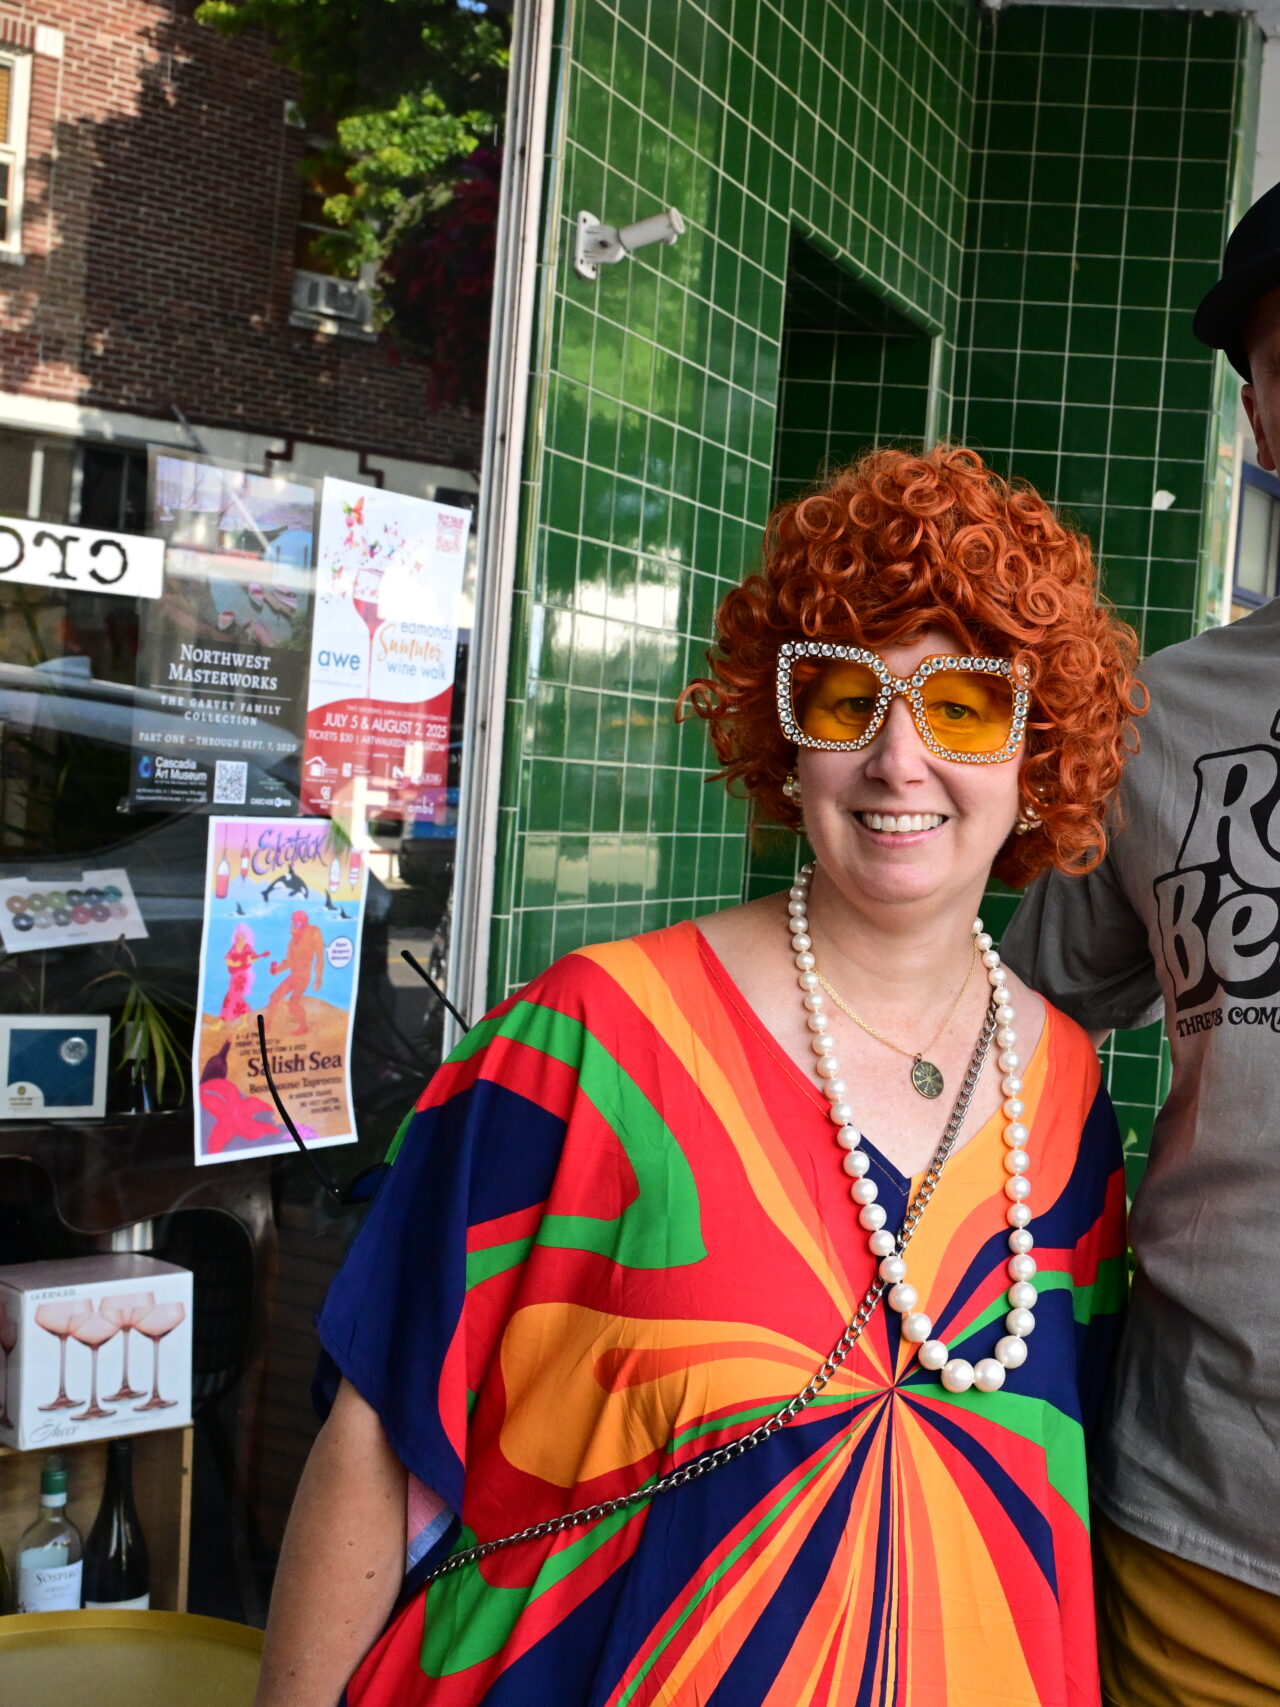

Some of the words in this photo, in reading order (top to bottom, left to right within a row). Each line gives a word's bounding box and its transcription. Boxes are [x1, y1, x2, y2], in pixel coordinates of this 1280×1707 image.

[180, 643, 271, 670] NORTHWEST
[318, 650, 361, 671] awe
[168, 663, 278, 690] MASTERWORKS
[387, 660, 417, 676] wine
[421, 663, 447, 680] walk
[160, 695, 185, 706] THE
[190, 698, 236, 712] GARVEY
[240, 702, 282, 716] FAMILY
[184, 711, 258, 726] COLLECTION
[323, 712, 349, 727] JULY
[350, 715, 358, 729] 5
[372, 718, 413, 735] AUGUST
[139, 732, 162, 743] PART
[164, 733, 186, 744] ONE
[196, 735, 239, 748] THROUGH
[308, 729, 338, 742] TICKETS
[155, 756, 197, 769] Cascadia
[155, 768, 169, 779] Art
[170, 769, 208, 781] Museum
[308, 1051, 342, 1071] Sea
